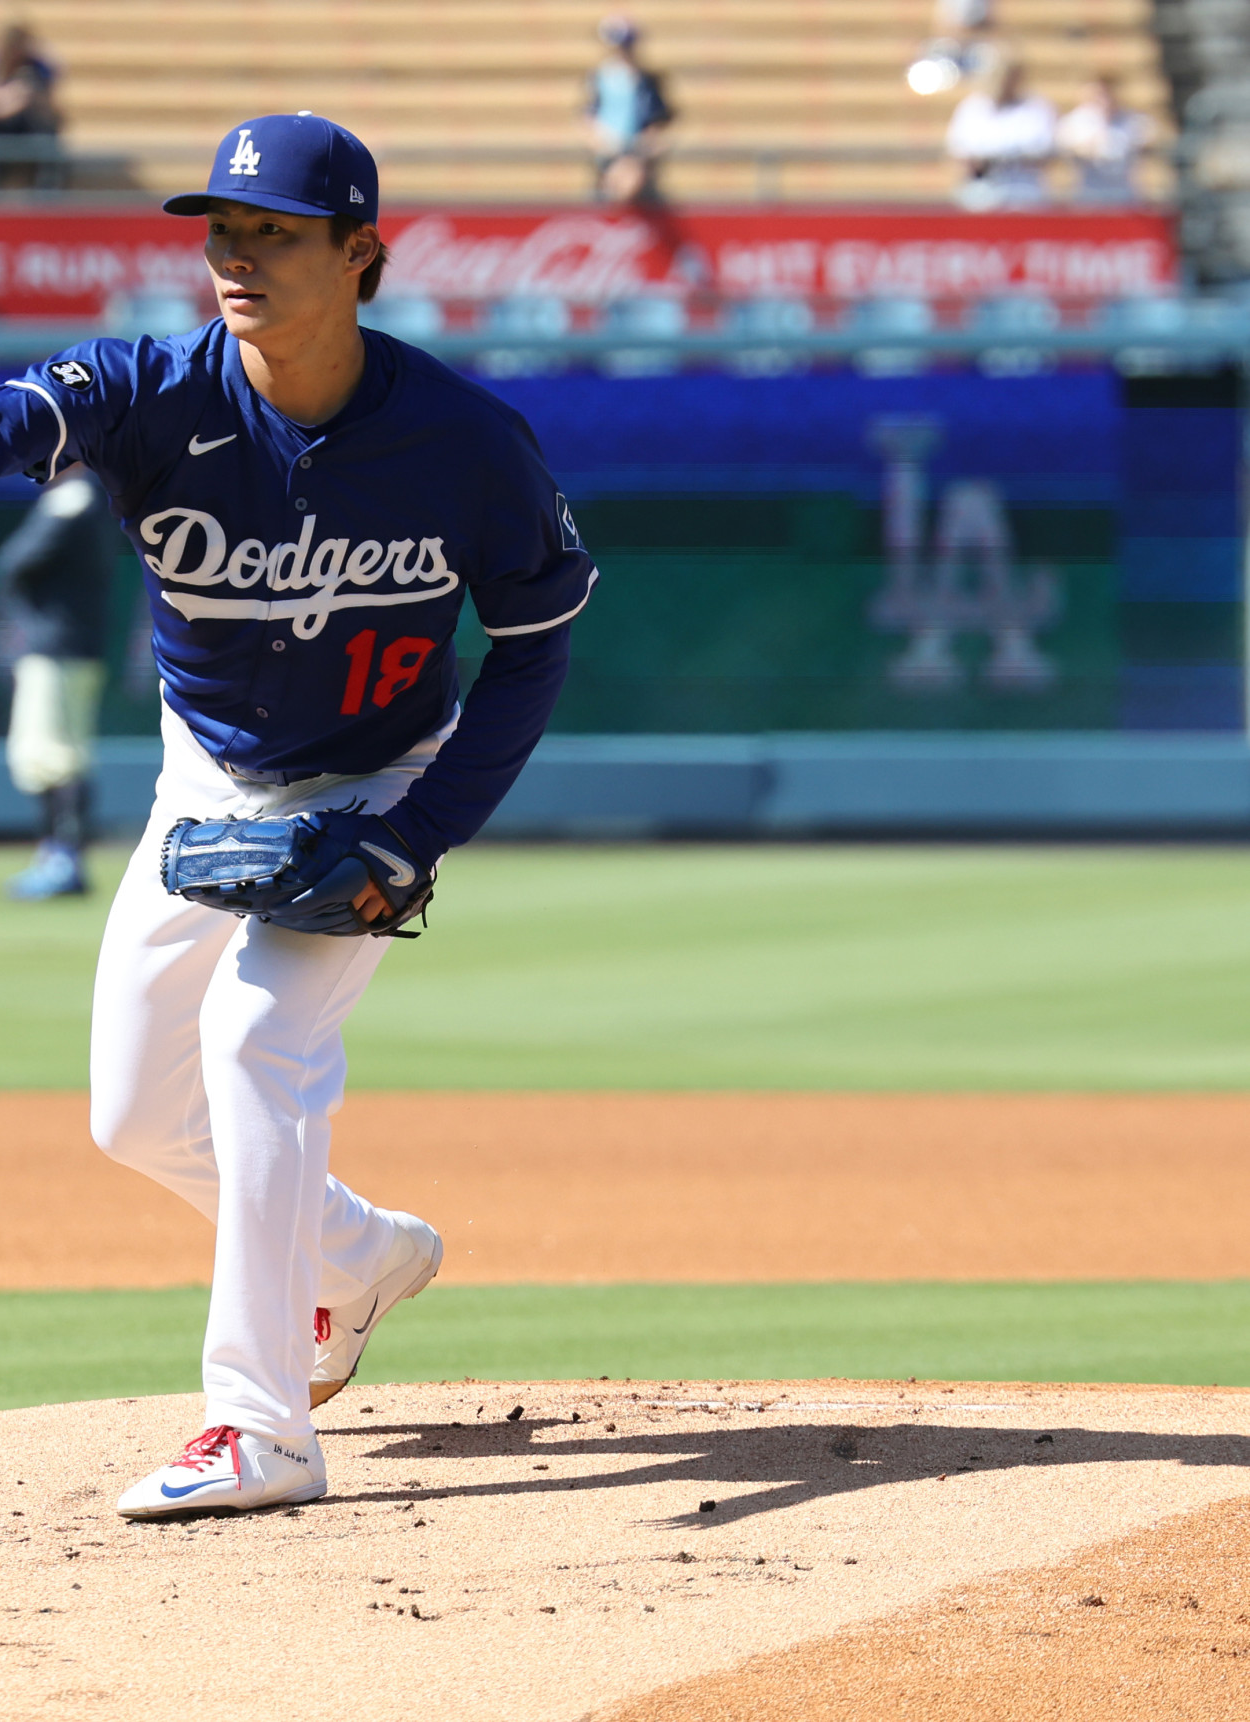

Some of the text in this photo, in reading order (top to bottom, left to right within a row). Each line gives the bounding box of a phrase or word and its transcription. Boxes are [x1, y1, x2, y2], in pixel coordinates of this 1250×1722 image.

[229, 129, 261, 176] LA
[140, 507, 459, 641] Dodgers
[863, 412, 1064, 695] LA
[340, 628, 437, 716] 18
